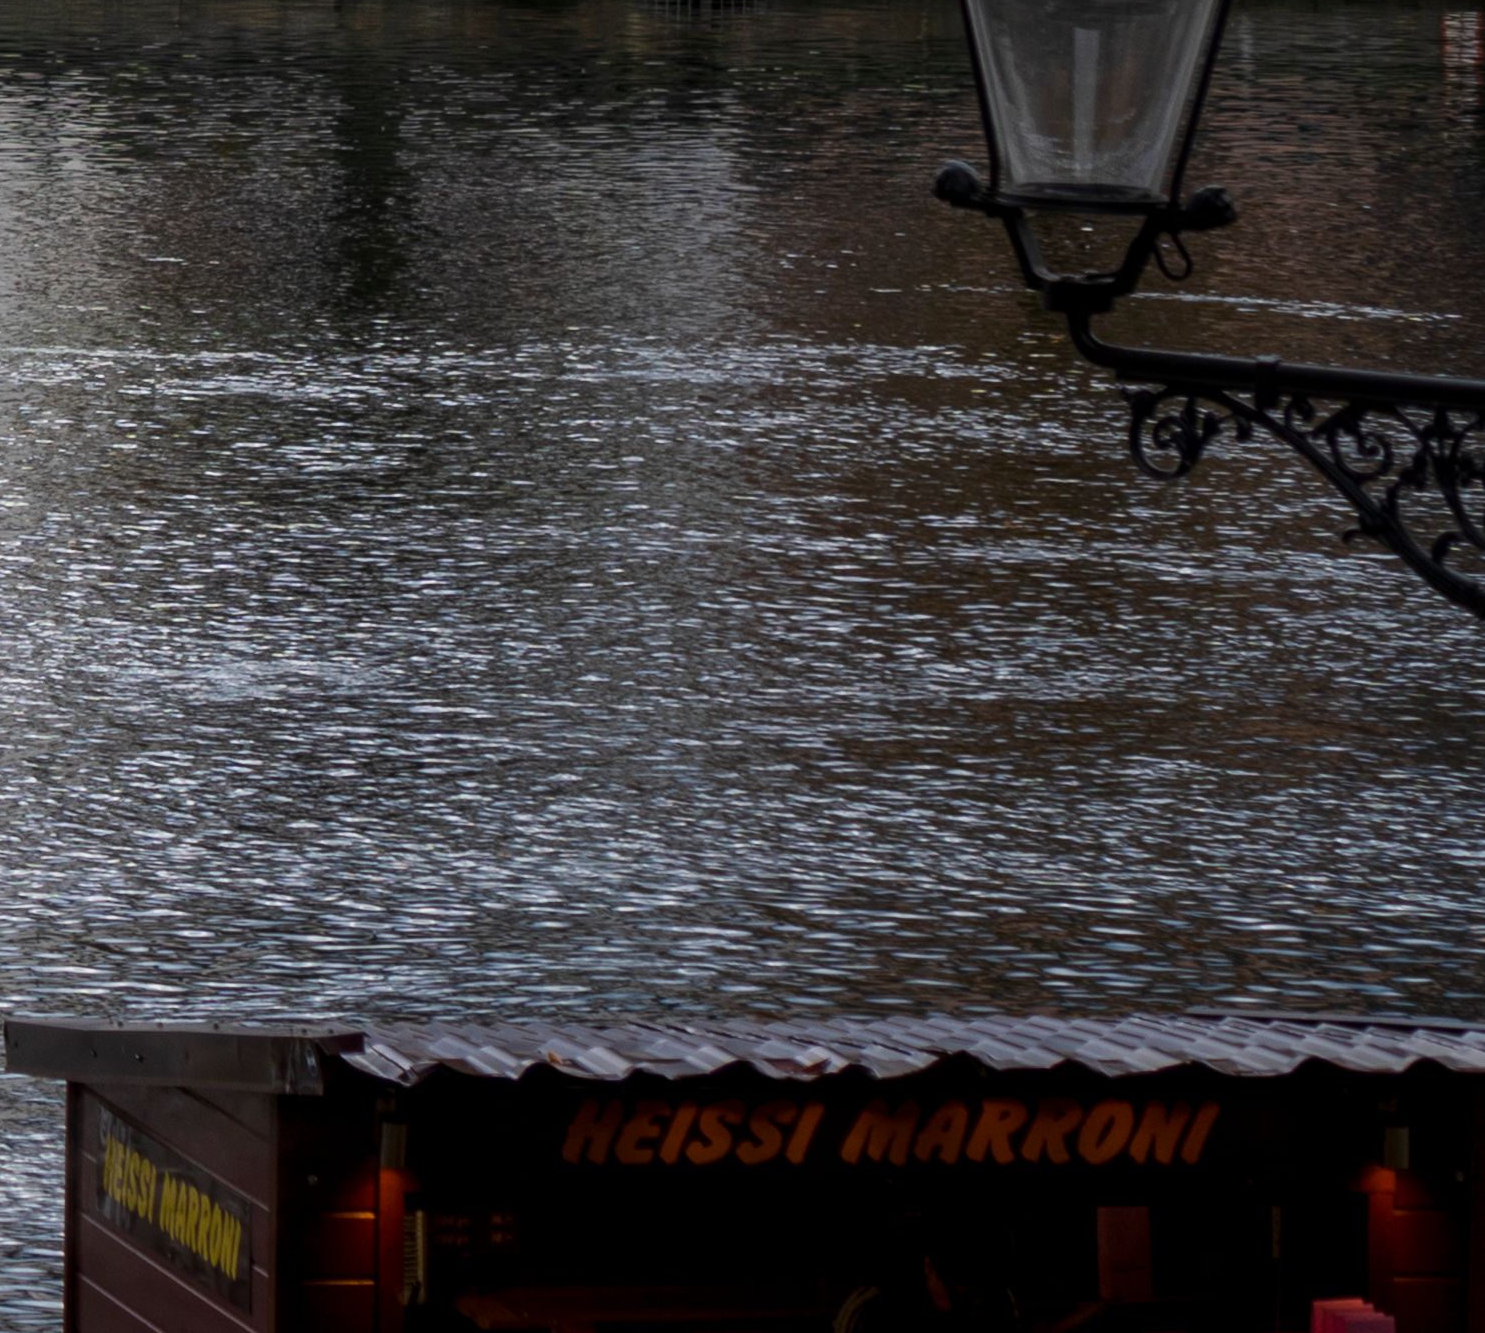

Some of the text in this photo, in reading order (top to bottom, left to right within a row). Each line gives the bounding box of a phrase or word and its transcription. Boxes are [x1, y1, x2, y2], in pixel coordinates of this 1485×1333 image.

[562, 1097, 1222, 1166] HEISSI MARRONI
[102, 1133, 242, 1282] HEISSI MARRONI
